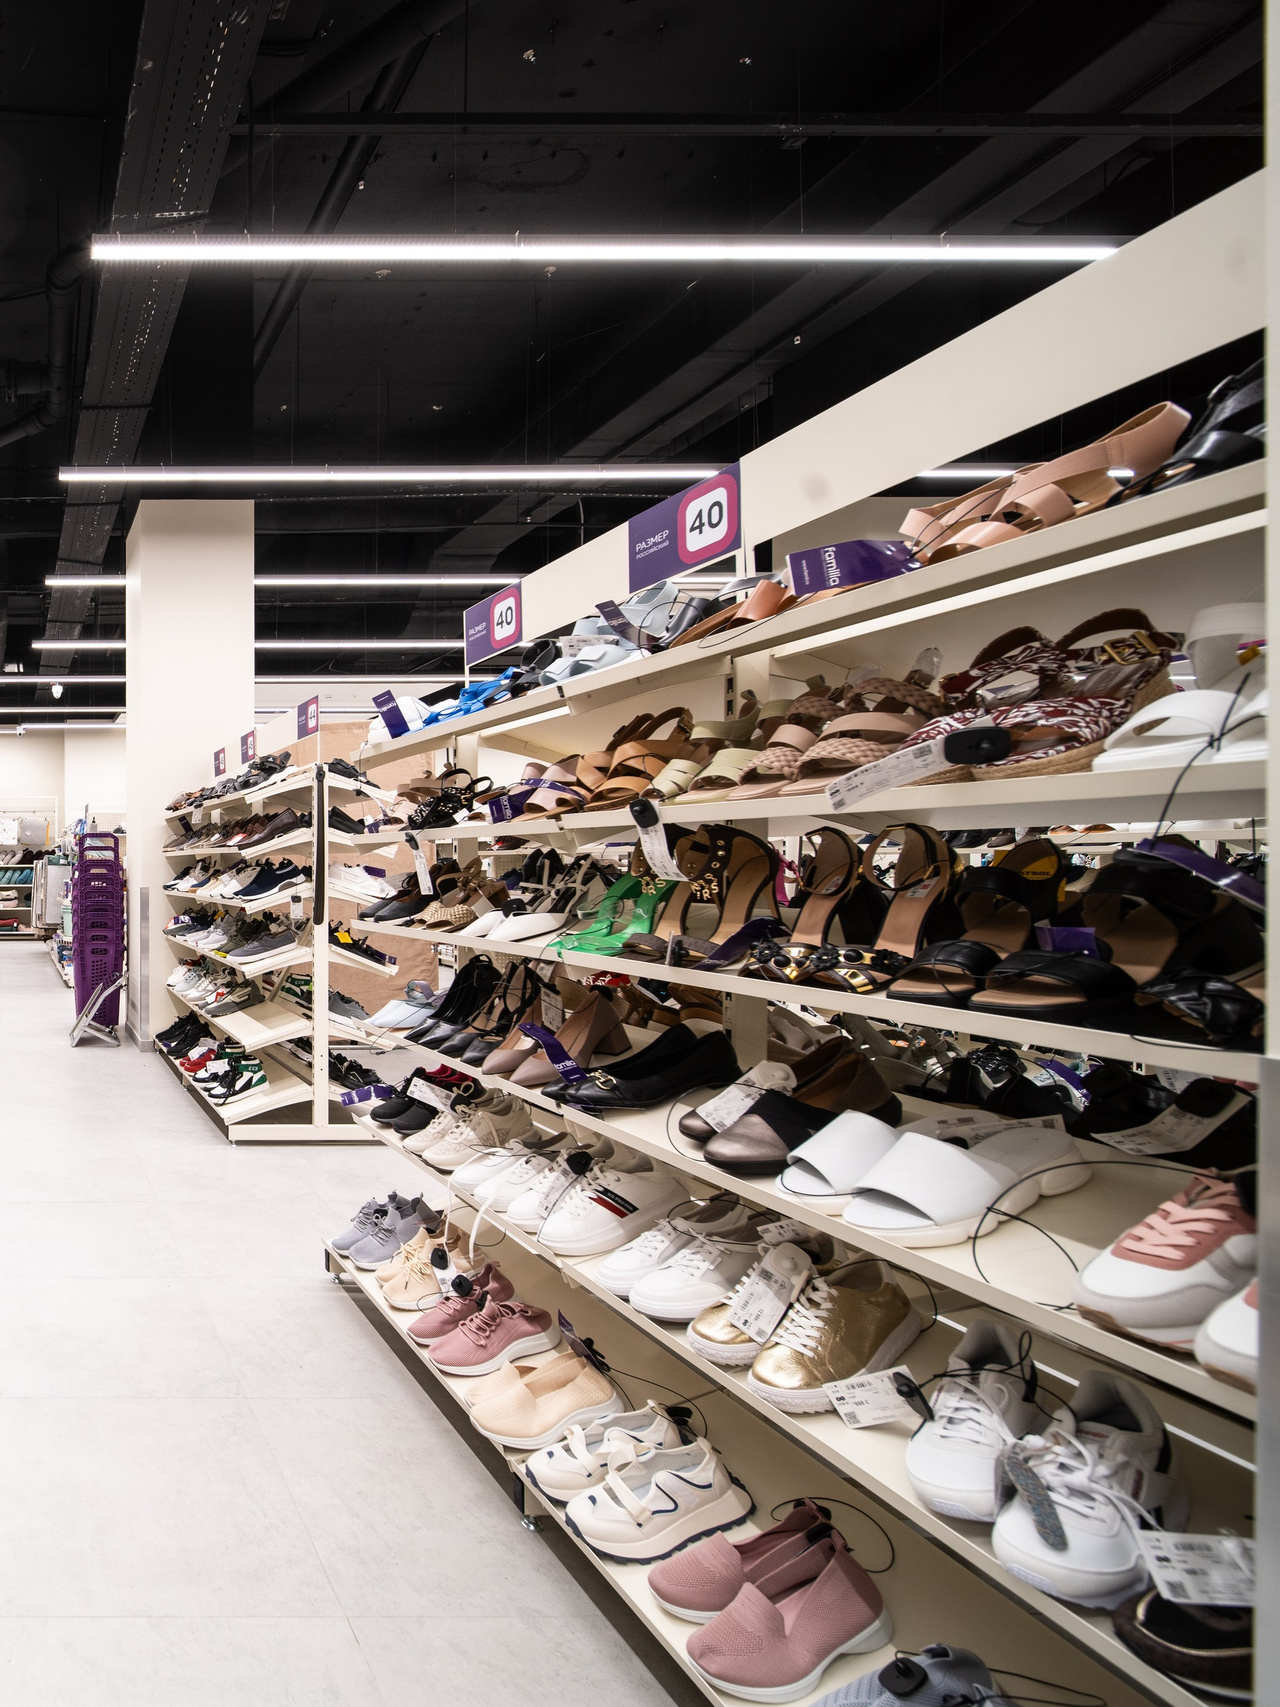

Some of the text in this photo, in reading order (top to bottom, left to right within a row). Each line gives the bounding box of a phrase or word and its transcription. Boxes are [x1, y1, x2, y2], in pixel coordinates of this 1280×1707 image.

[689, 500, 724, 536] 40
[635, 529, 670, 552] РАЗМЕР
[635, 539, 670, 560] РОССИЙСКИЙ
[824, 546, 840, 587] familia
[496, 605, 513, 629] 40
[468, 622, 487, 637] РАЗМЕР
